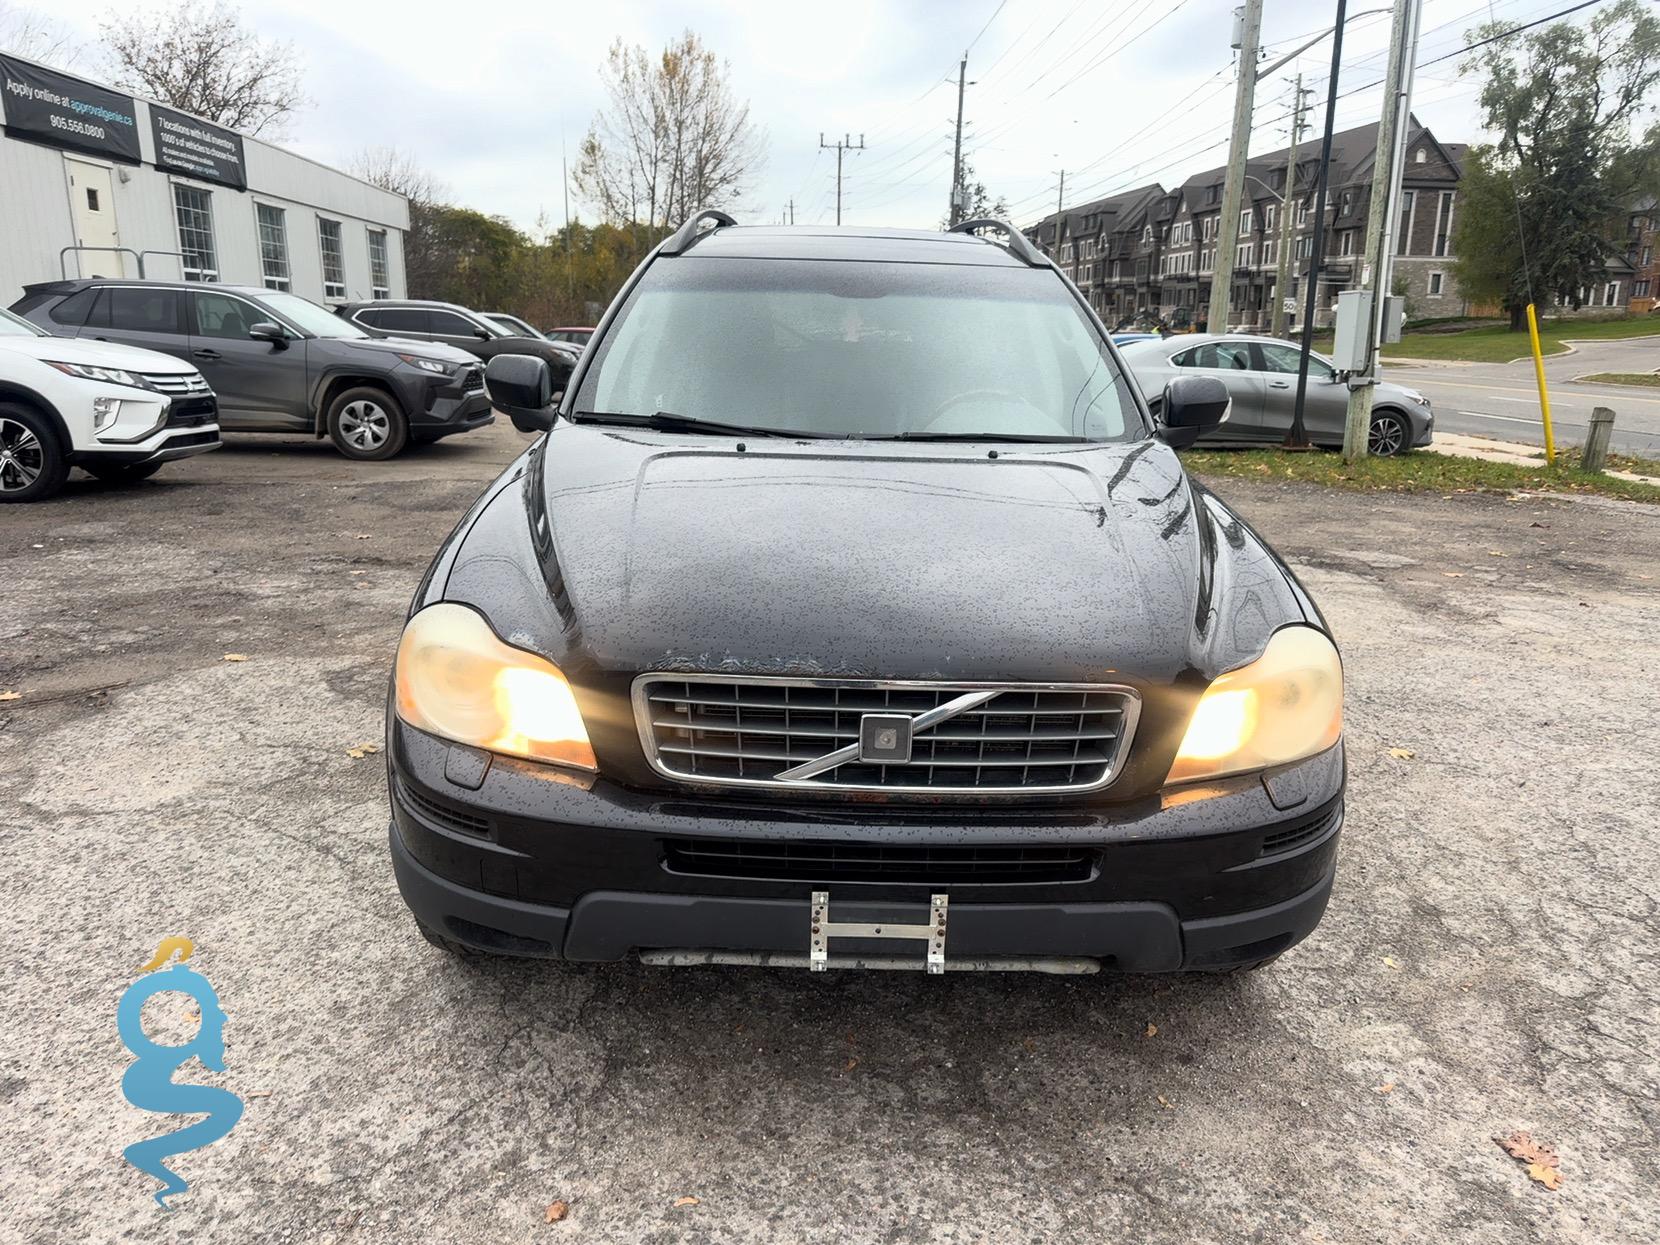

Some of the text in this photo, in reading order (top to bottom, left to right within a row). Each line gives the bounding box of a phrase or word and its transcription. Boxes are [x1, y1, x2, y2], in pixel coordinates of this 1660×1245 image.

[6, 78, 133, 126] Apply online at approvalgenie.ca
[50, 114, 105, 140] 905.556.0800
[158, 117, 163, 127] 7
